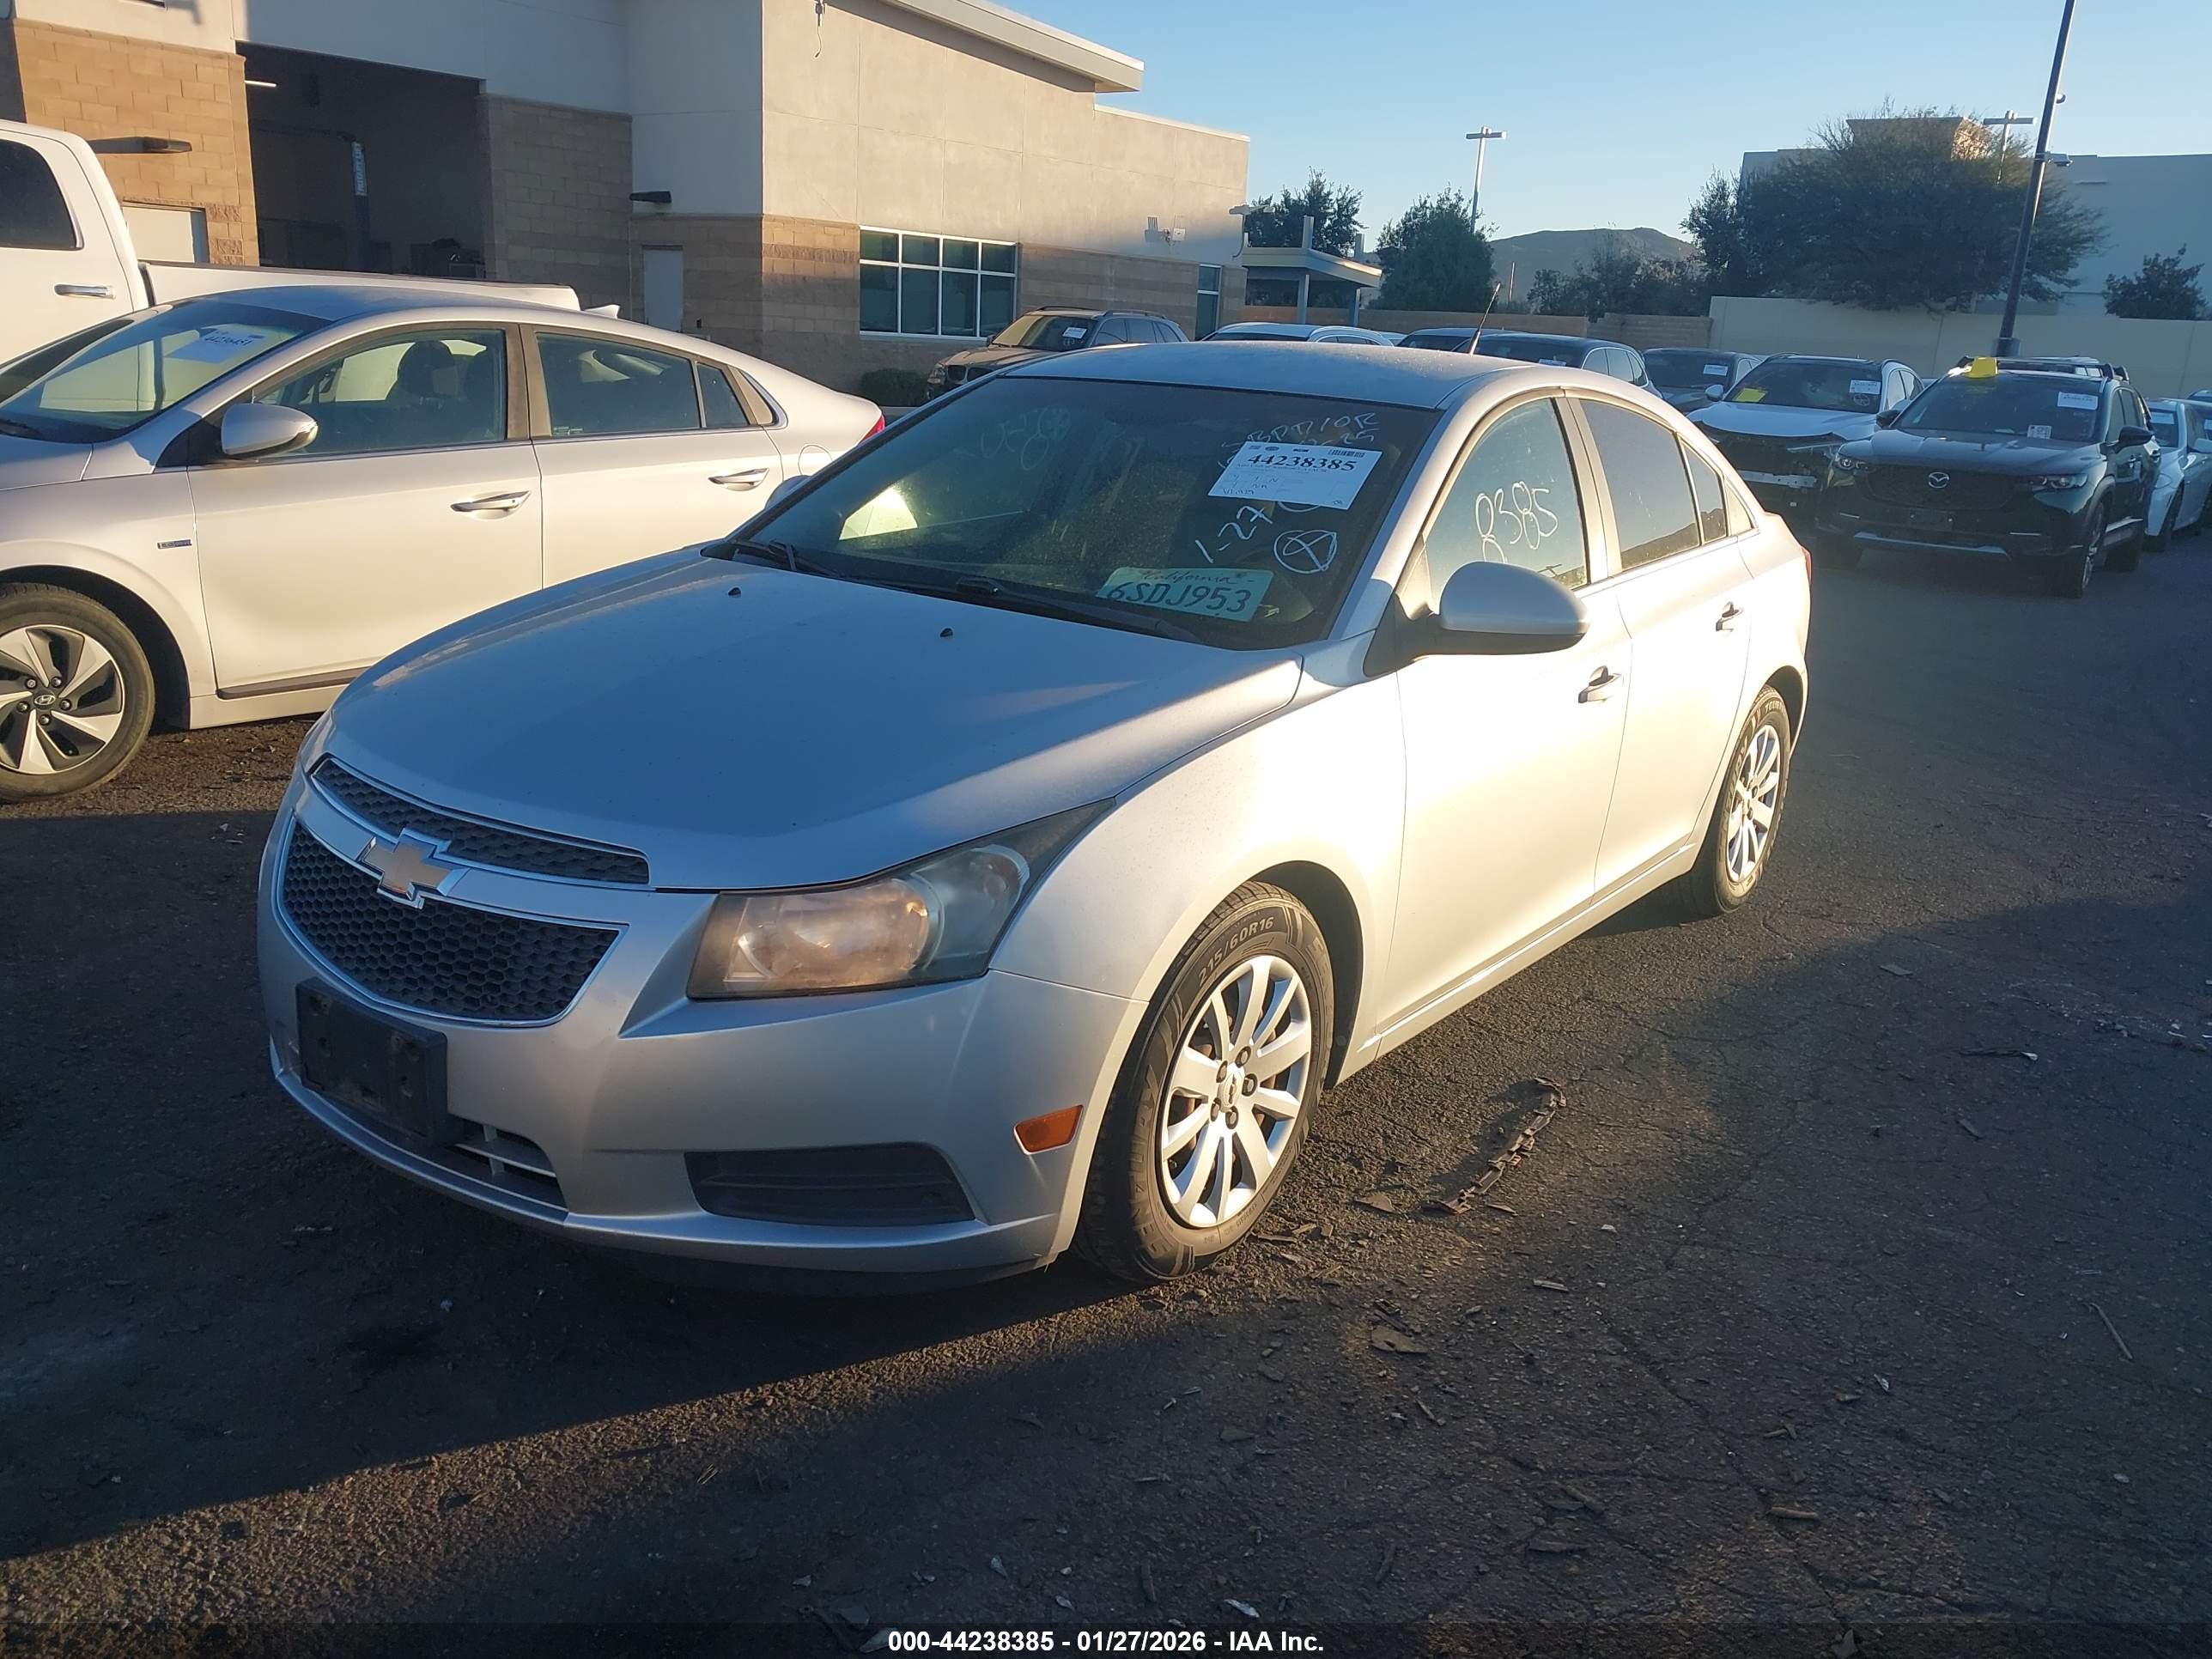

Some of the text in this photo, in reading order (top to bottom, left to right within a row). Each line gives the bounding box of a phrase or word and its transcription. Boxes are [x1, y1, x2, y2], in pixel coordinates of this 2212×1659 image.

[1248, 453, 1358, 471] 44238385
[1194, 505, 1273, 564] 1-27
[1475, 481, 1559, 563] 8385
[1107, 581, 1252, 612] 6SDJ953
[1199, 917, 1275, 987] 215/60R16
